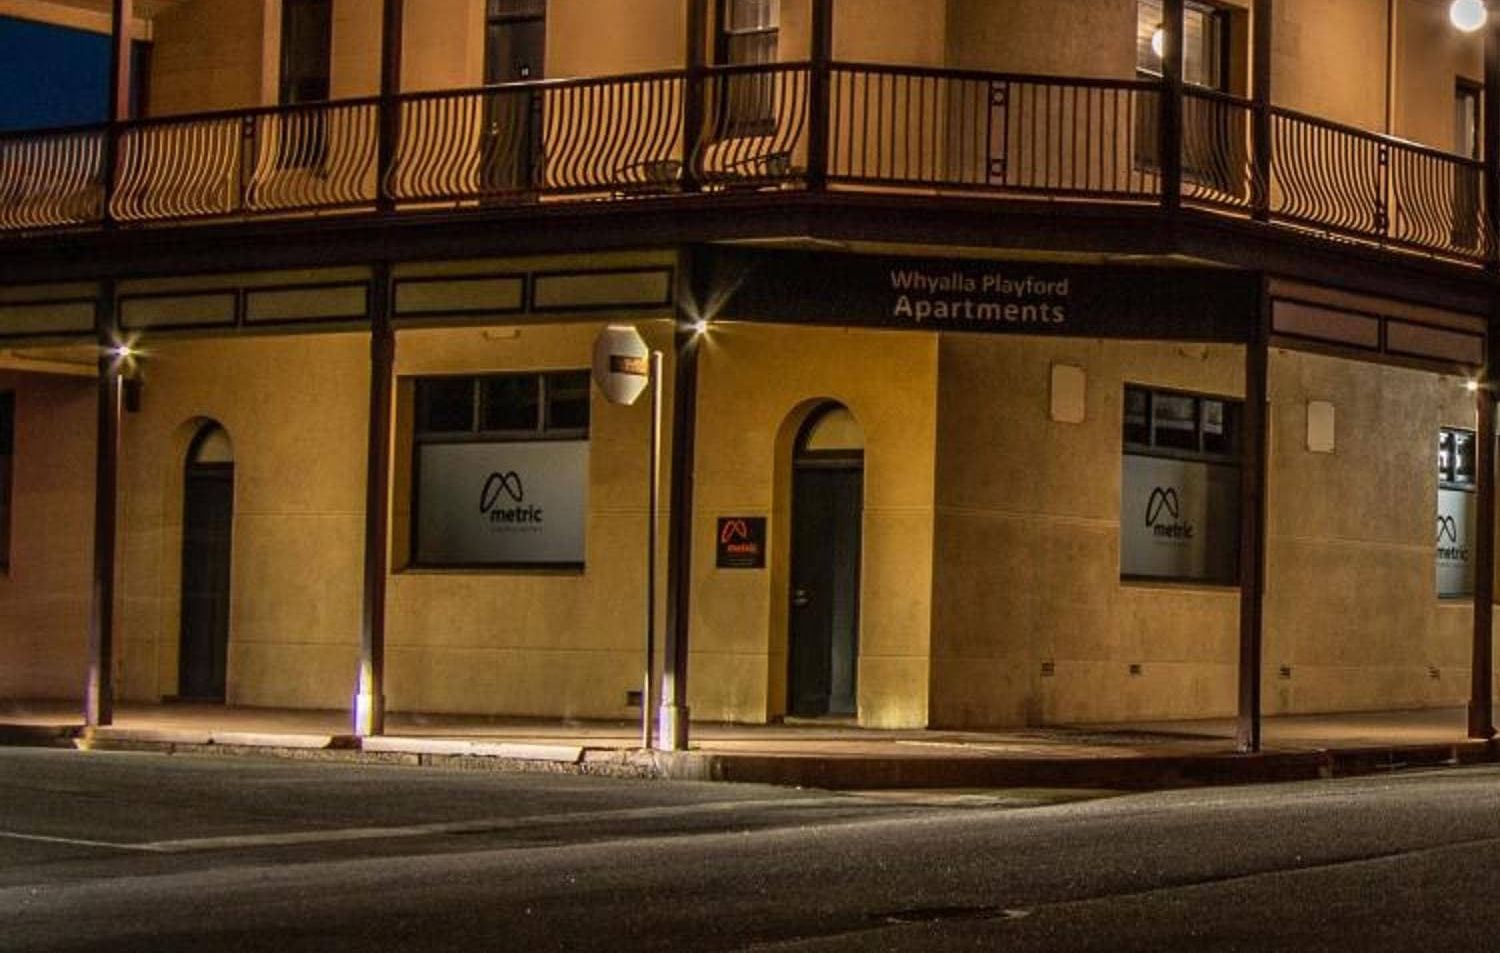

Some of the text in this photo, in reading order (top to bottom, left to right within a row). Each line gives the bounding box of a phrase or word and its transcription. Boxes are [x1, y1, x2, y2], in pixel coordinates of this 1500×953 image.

[890, 269, 1070, 298] Whyalla Playford
[894, 295, 1067, 324] Apartments
[490, 504, 543, 523] metric
[1153, 521, 1193, 538] metric
